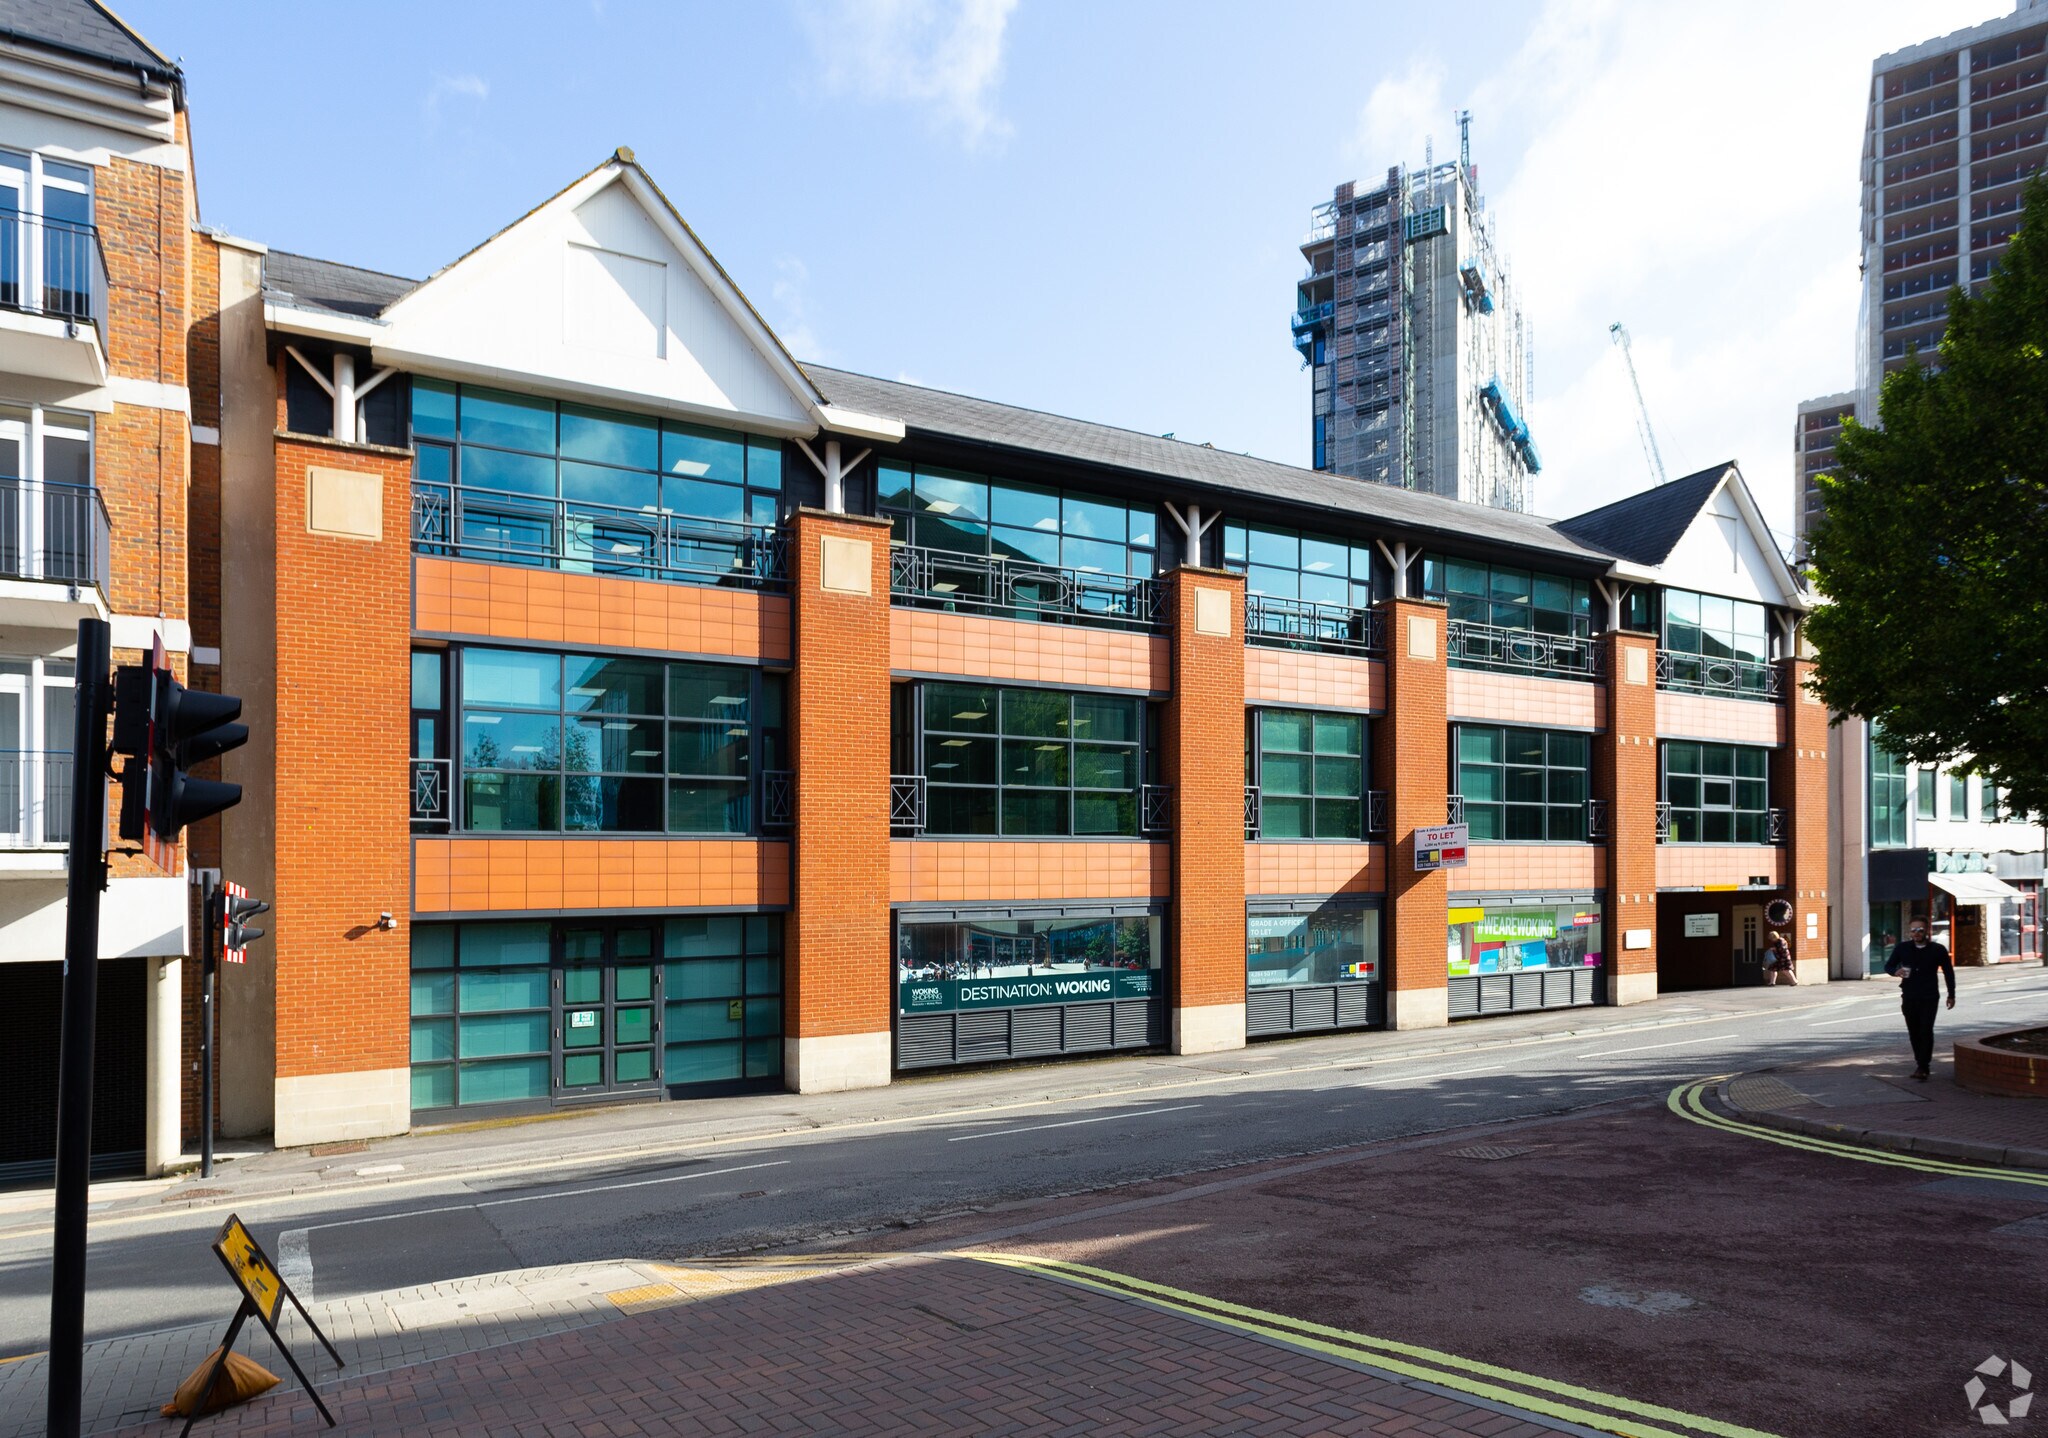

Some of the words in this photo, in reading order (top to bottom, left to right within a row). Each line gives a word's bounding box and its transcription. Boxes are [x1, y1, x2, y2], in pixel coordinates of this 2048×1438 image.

[1427, 833, 1438, 841] TO
[1439, 831, 1455, 840] LET
[1477, 915, 1553, 938] #WEAREWOKING
[911, 987, 939, 995] WOKING
[961, 982, 1053, 1002] DESTINATION:
[1055, 979, 1111, 995] WOKING
[911, 993, 943, 1001] SHOPPING
